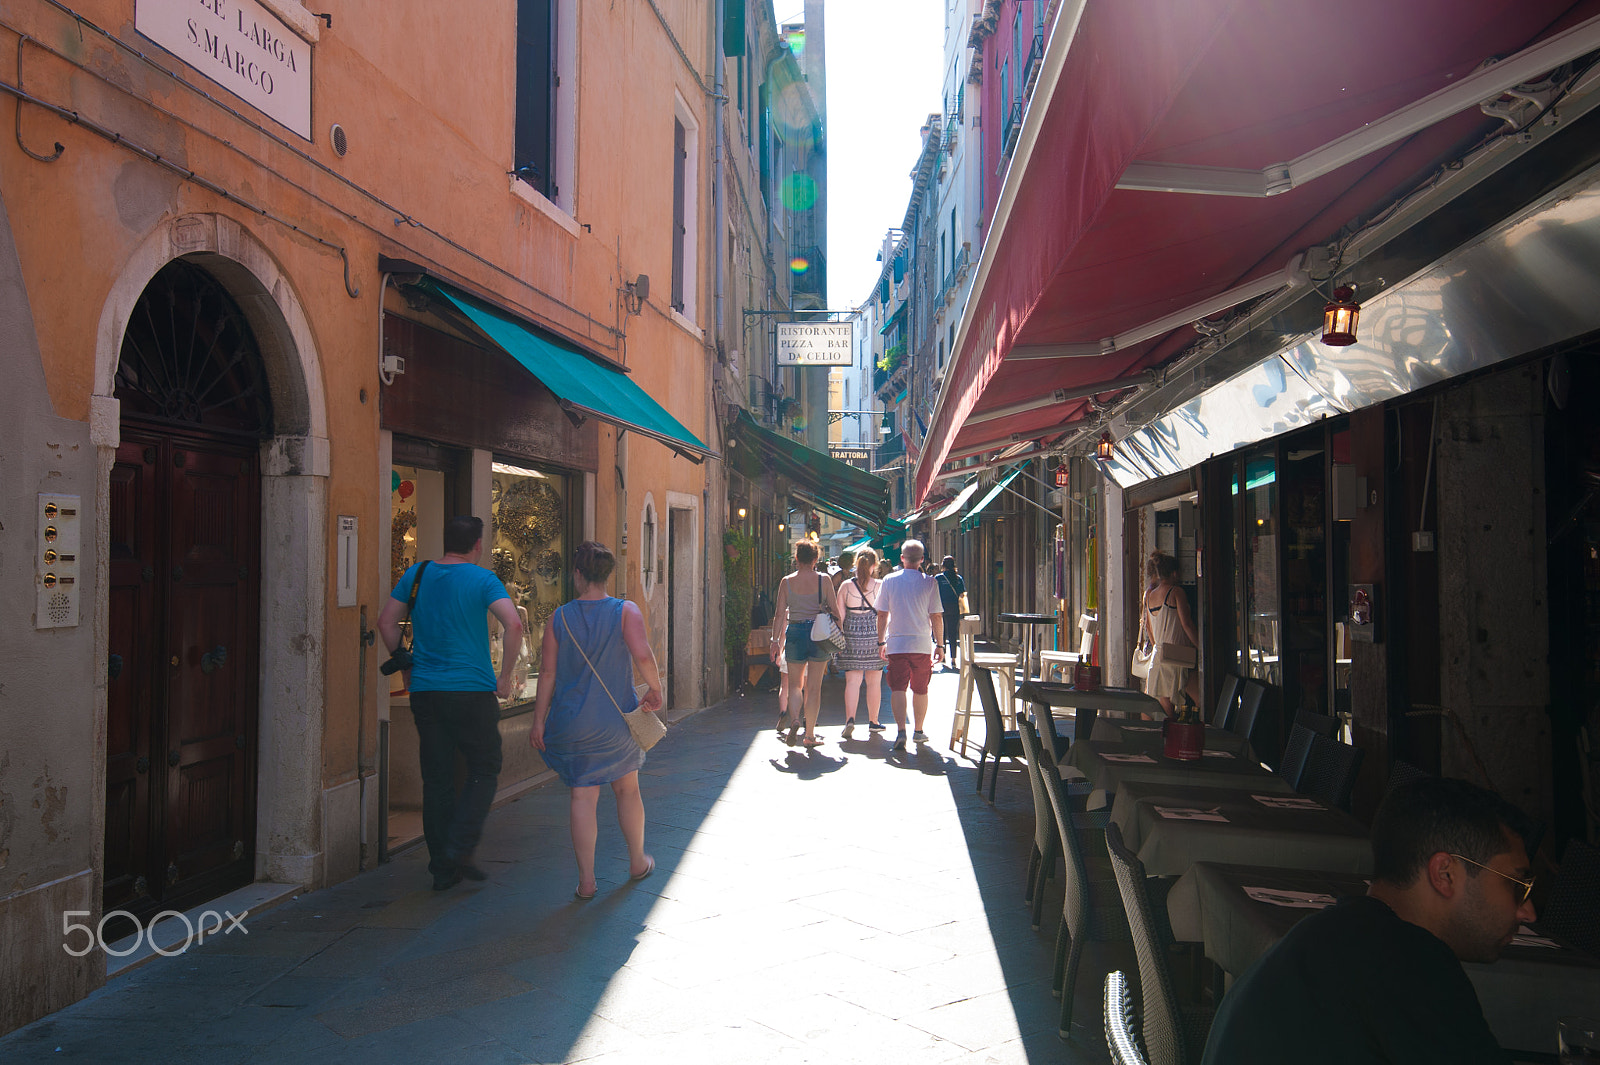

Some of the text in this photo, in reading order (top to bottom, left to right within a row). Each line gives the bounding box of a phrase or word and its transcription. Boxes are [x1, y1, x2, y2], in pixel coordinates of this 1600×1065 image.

[238, 9, 297, 73] LARGA
[781, 327, 850, 336] RISTORANTE
[781, 340, 849, 348] PIZZA BAR
[788, 352, 841, 361] DA CELIO
